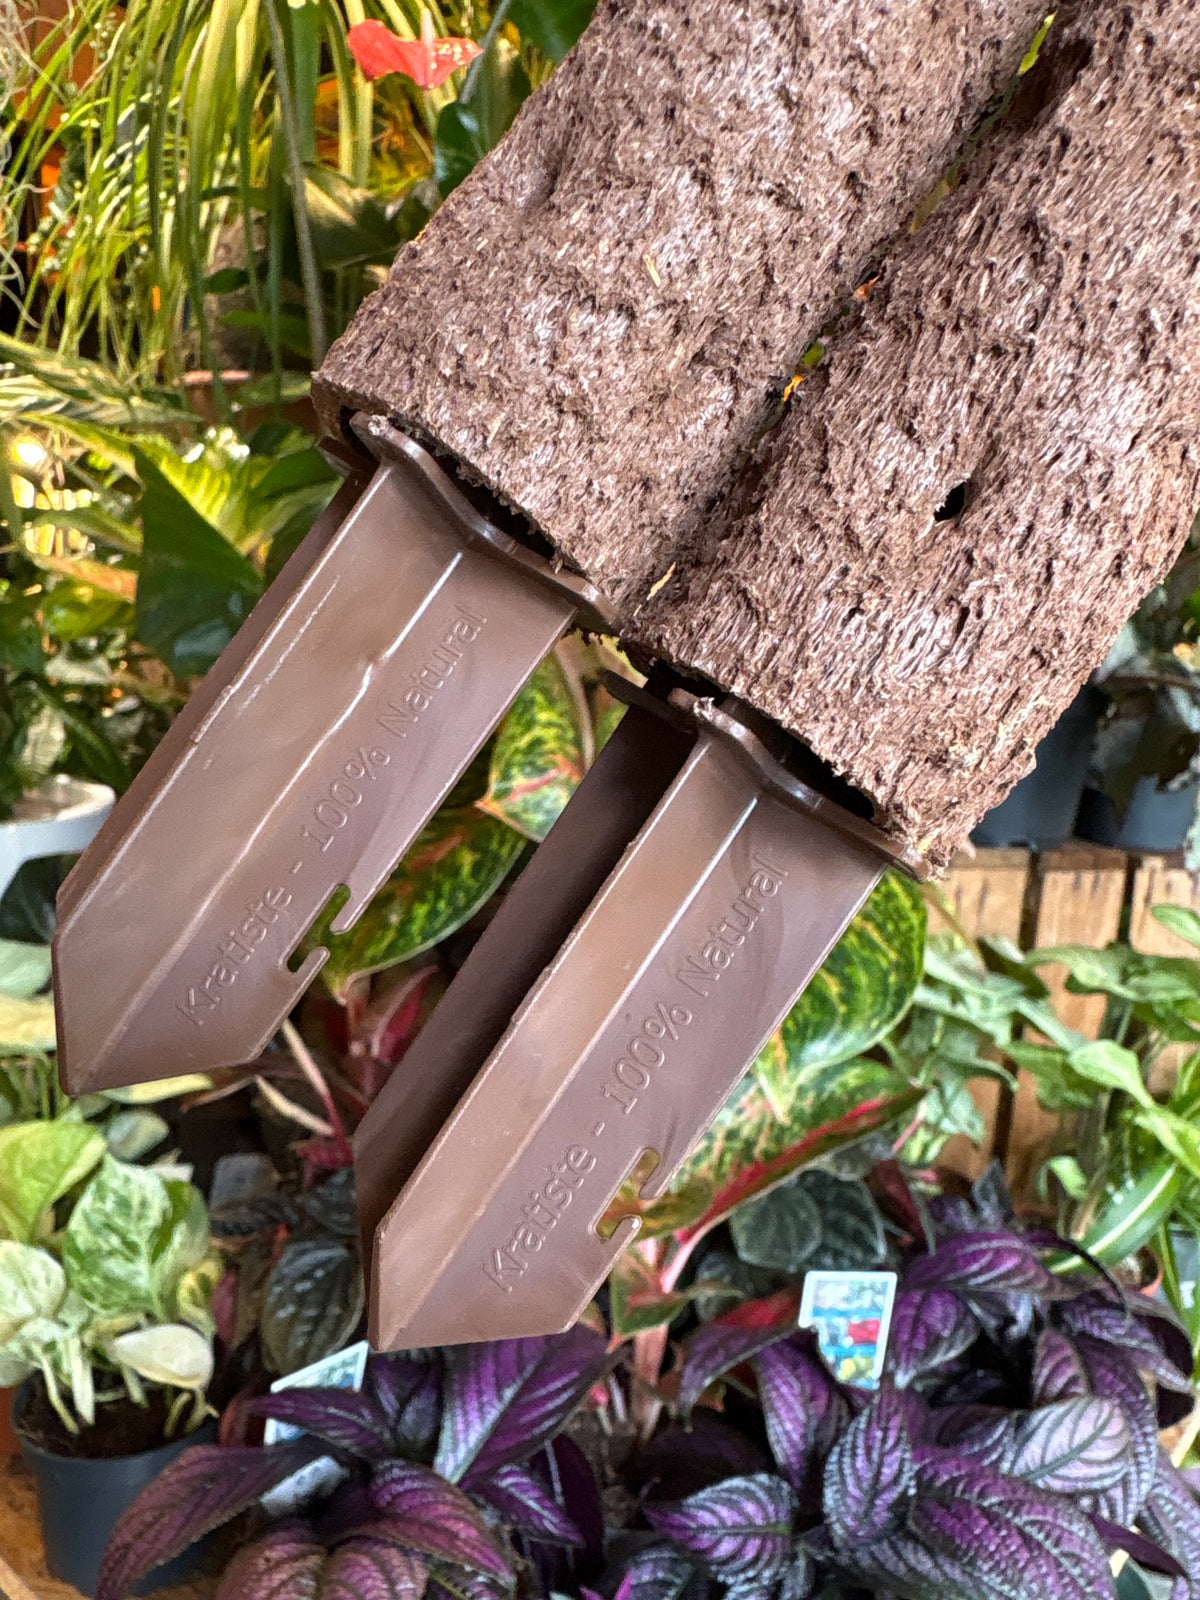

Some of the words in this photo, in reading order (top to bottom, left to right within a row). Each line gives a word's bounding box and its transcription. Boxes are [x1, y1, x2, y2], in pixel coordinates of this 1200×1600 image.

[174, 884, 293, 1026] Kratiste
[302, 745, 391, 853] 100%
[377, 602, 488, 738] Natural
[480, 1143, 597, 1293] Kratiste
[601, 1002, 693, 1114] 100%
[674, 852, 789, 997] Natural
